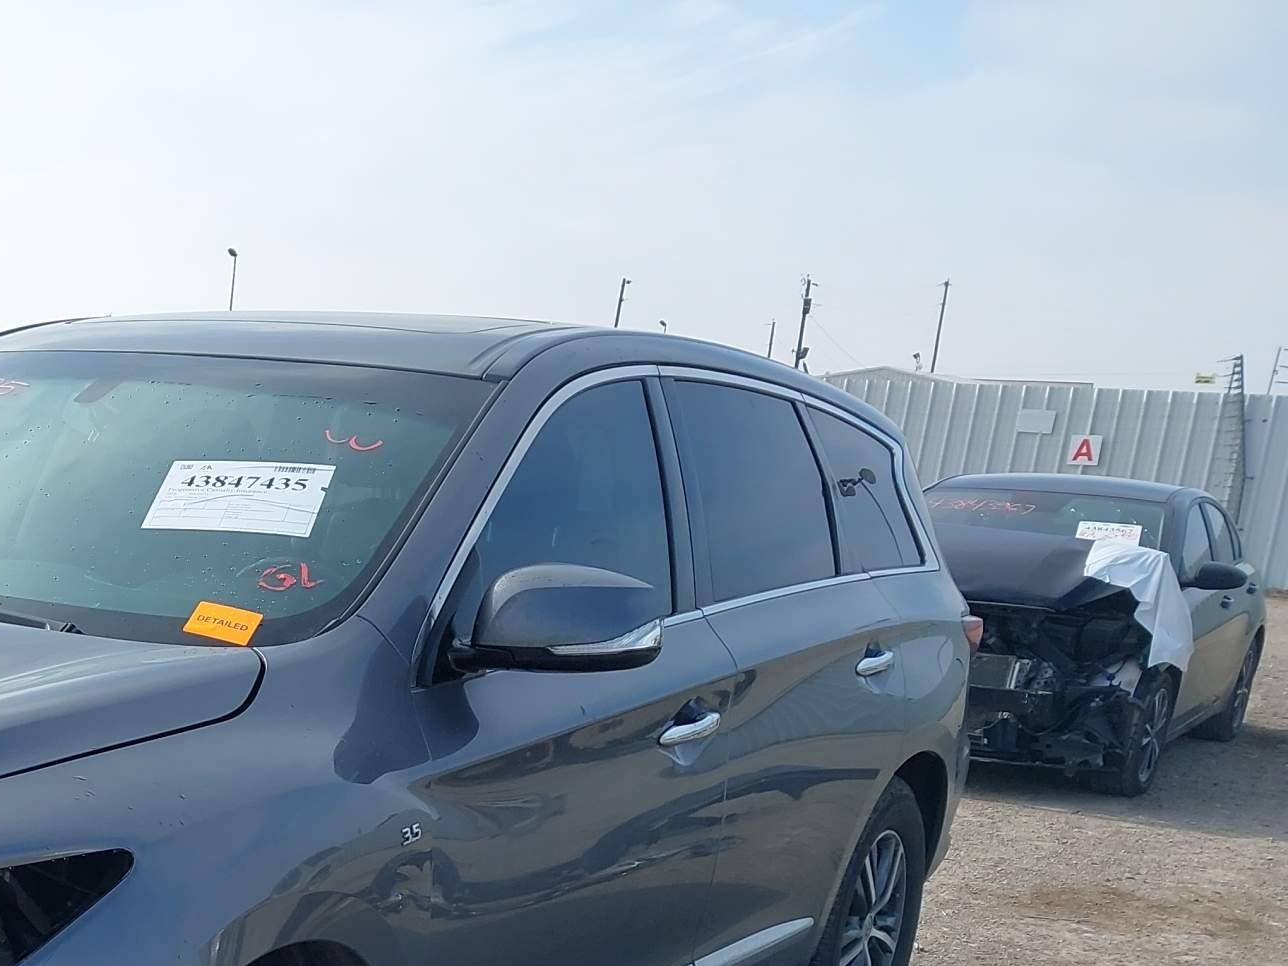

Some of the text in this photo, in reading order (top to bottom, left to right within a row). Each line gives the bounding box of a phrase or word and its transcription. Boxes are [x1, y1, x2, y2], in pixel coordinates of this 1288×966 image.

[1072, 438, 1093, 461] A
[181, 475, 309, 491] 43847435
[197, 614, 249, 632] DETAILED
